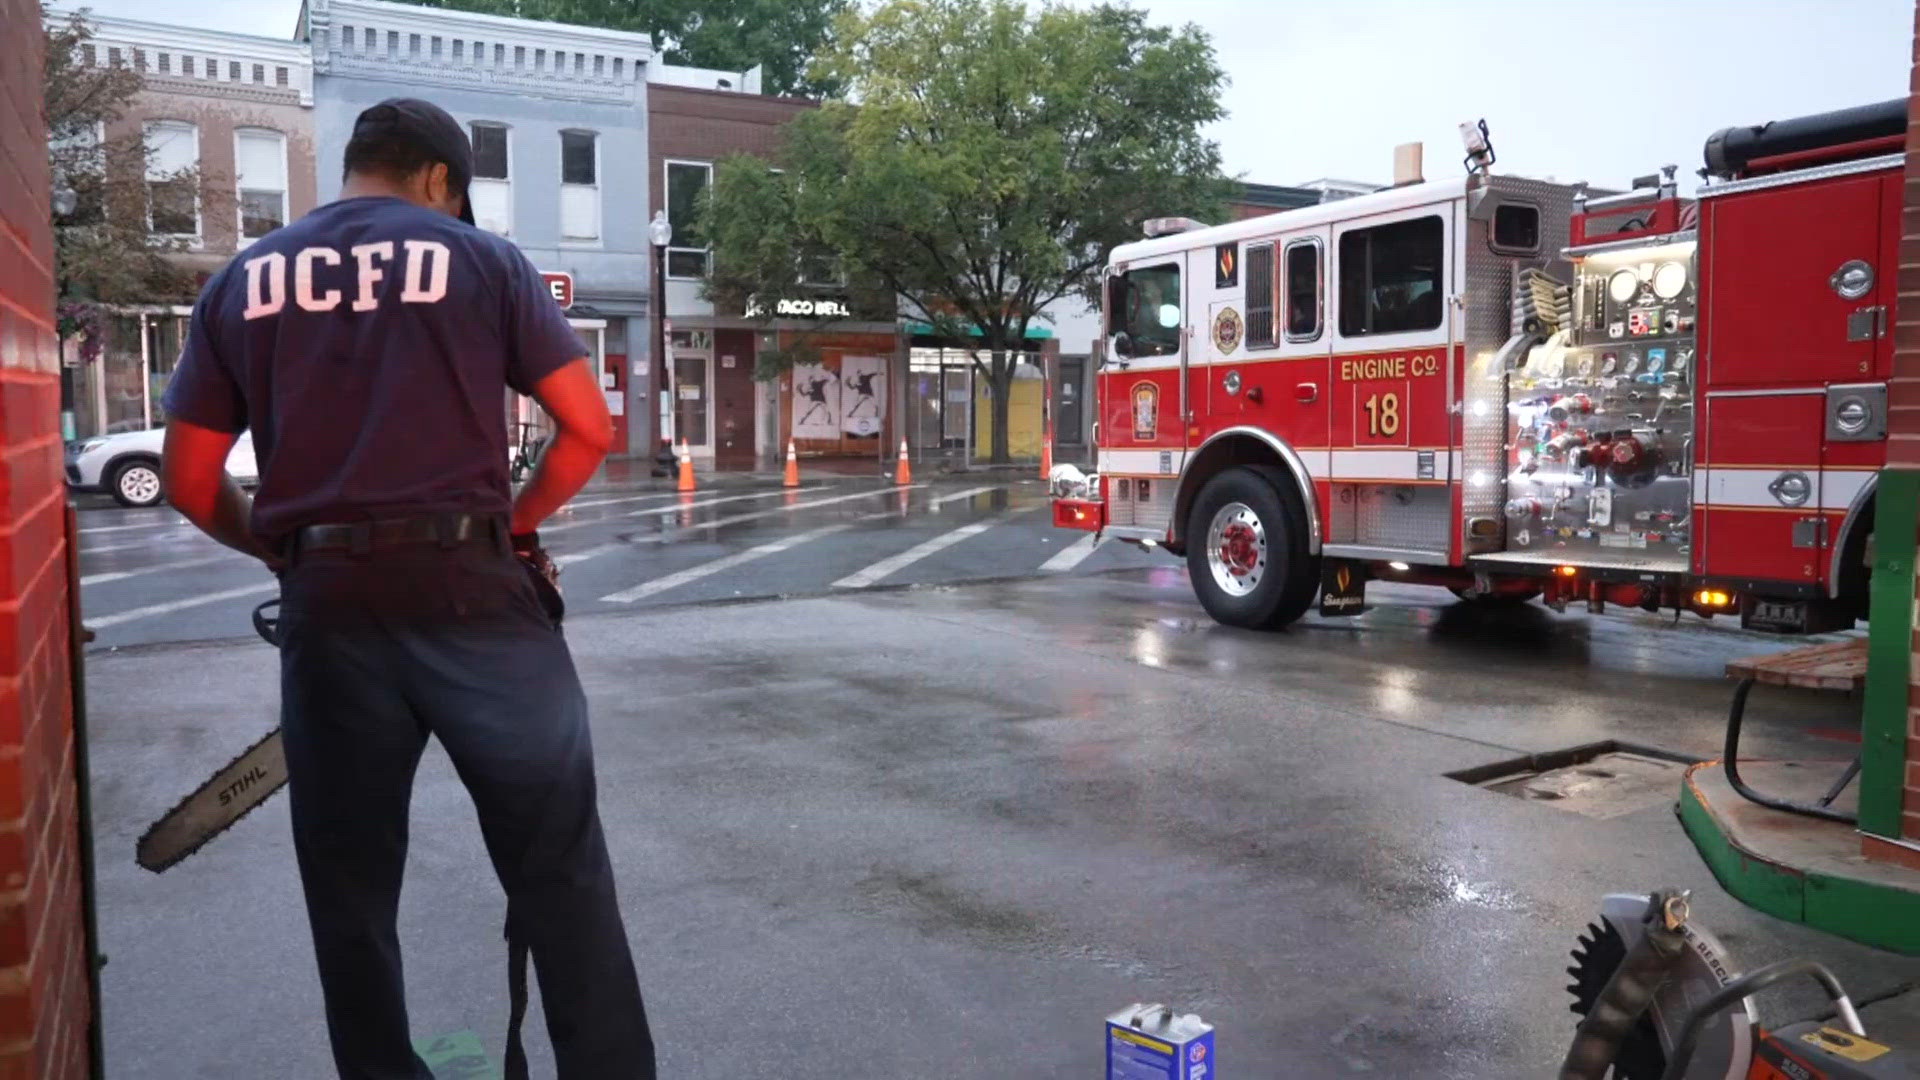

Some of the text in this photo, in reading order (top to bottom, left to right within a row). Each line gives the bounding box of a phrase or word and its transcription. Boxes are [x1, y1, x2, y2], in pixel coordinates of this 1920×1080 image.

[243, 239, 450, 321] DCFD
[1342, 358, 1405, 380] ENGINE
[1365, 393, 1399, 436] 18
[218, 766, 268, 807] STIHL
